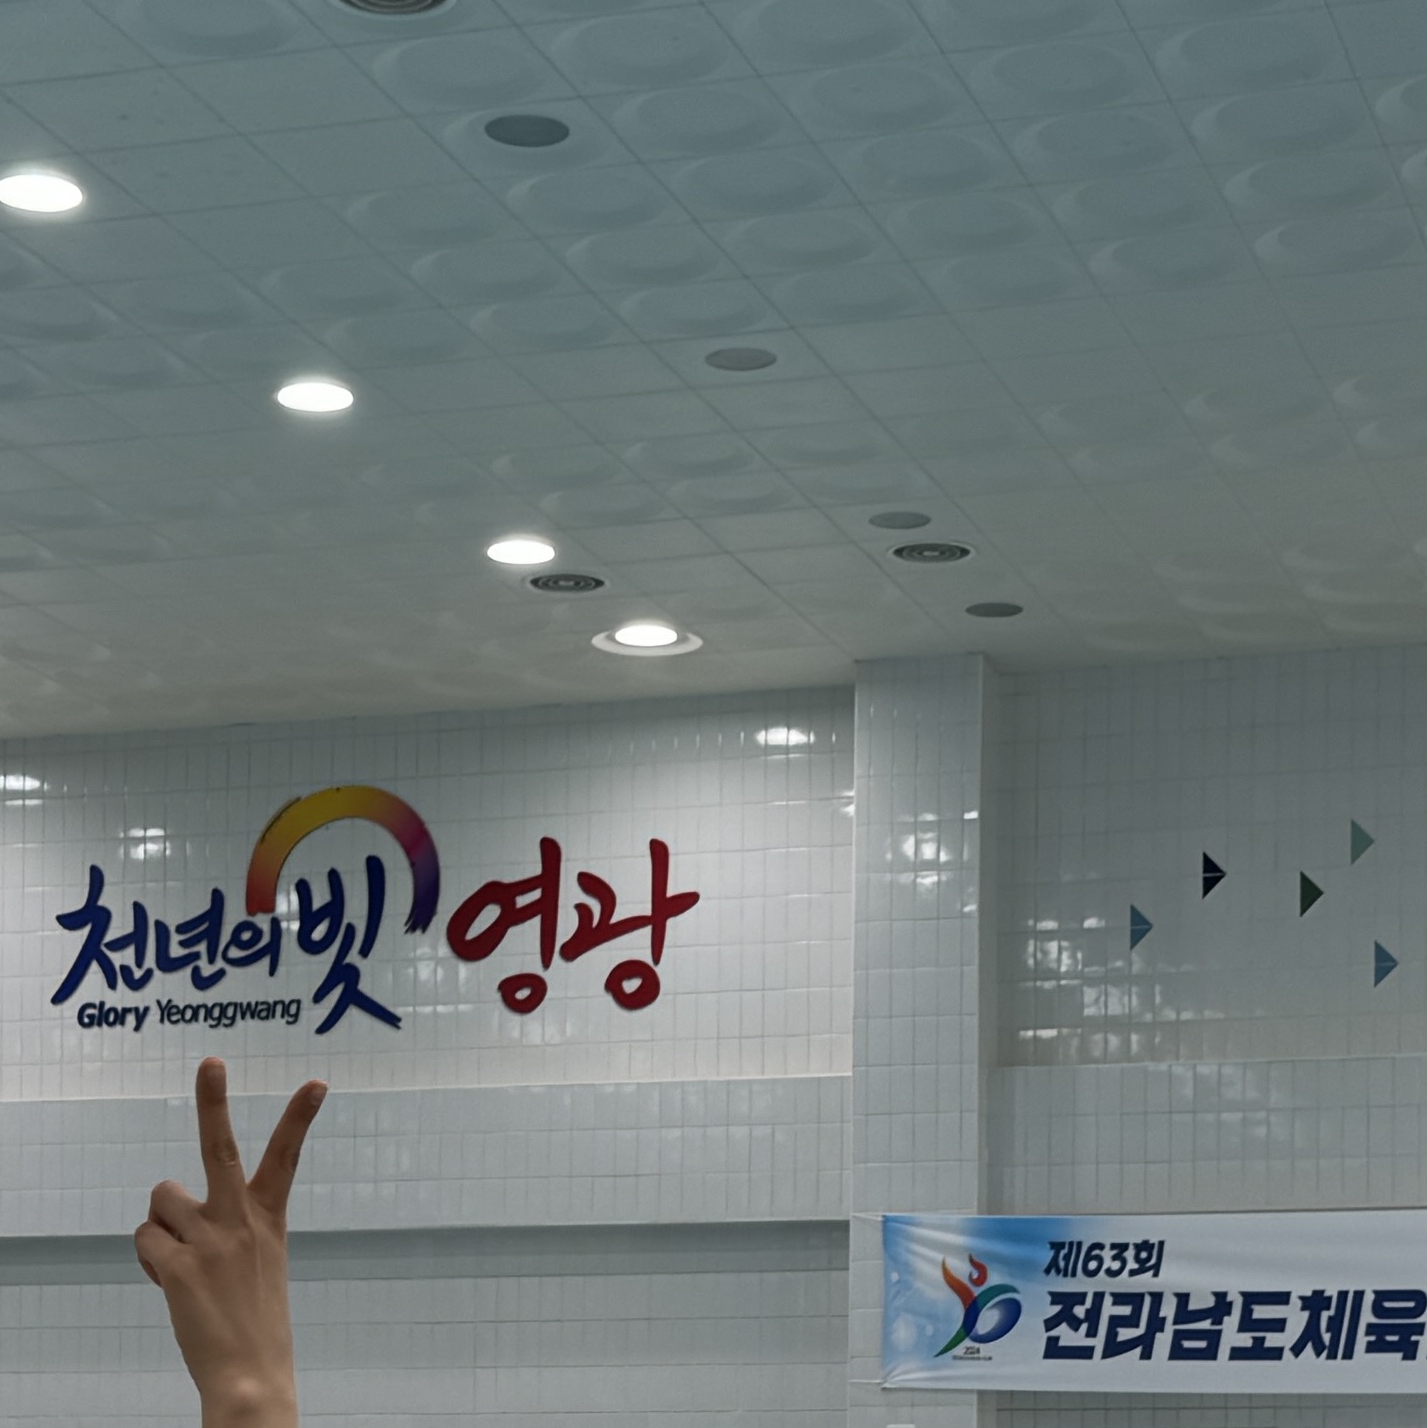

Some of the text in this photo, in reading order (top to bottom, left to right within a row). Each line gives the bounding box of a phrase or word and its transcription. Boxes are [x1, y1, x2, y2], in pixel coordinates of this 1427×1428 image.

[51, 863, 281, 1004] 천년의
[446, 836, 700, 1014] 영광
[76, 998, 302, 1033] Glory Yeonggwang
[1042, 1238, 1165, 1278] 제63회
